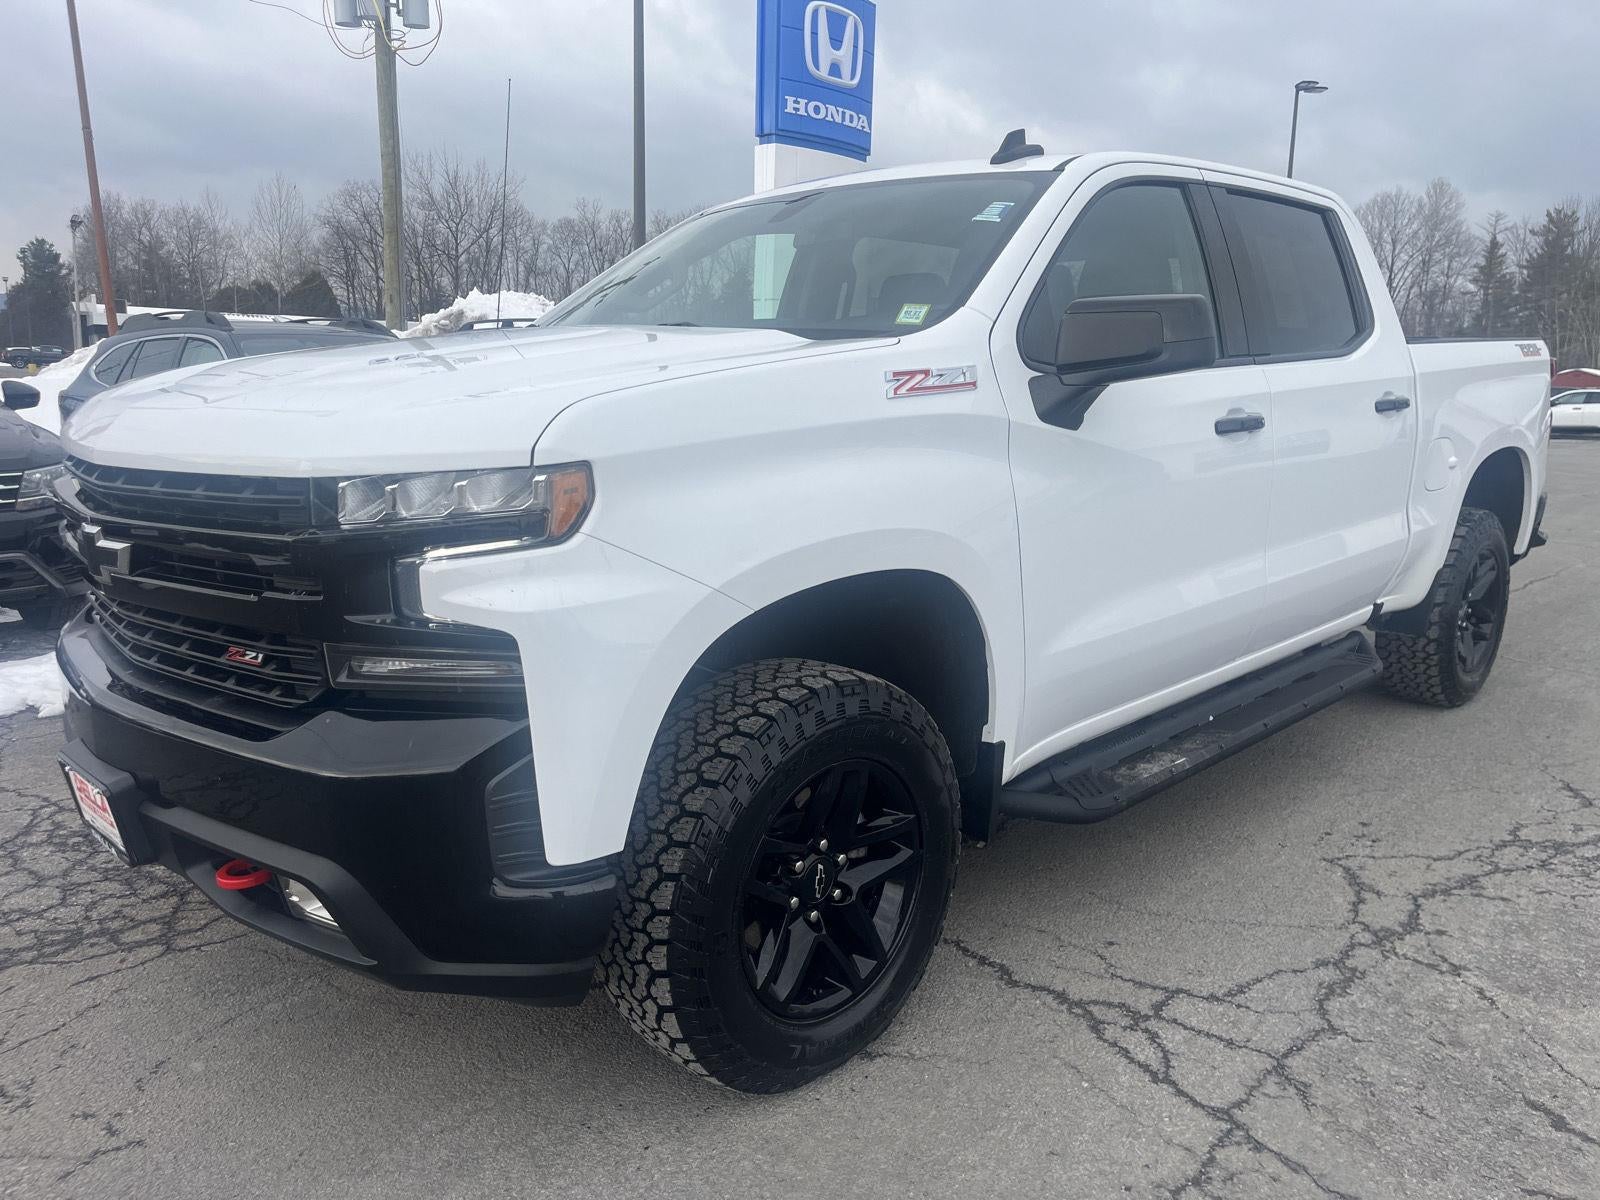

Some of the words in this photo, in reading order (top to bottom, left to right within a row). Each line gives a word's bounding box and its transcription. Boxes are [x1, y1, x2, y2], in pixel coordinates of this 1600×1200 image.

[784, 95, 870, 133] HONDA
[885, 365, 977, 400] Z71
[226, 646, 264, 667] Z71
